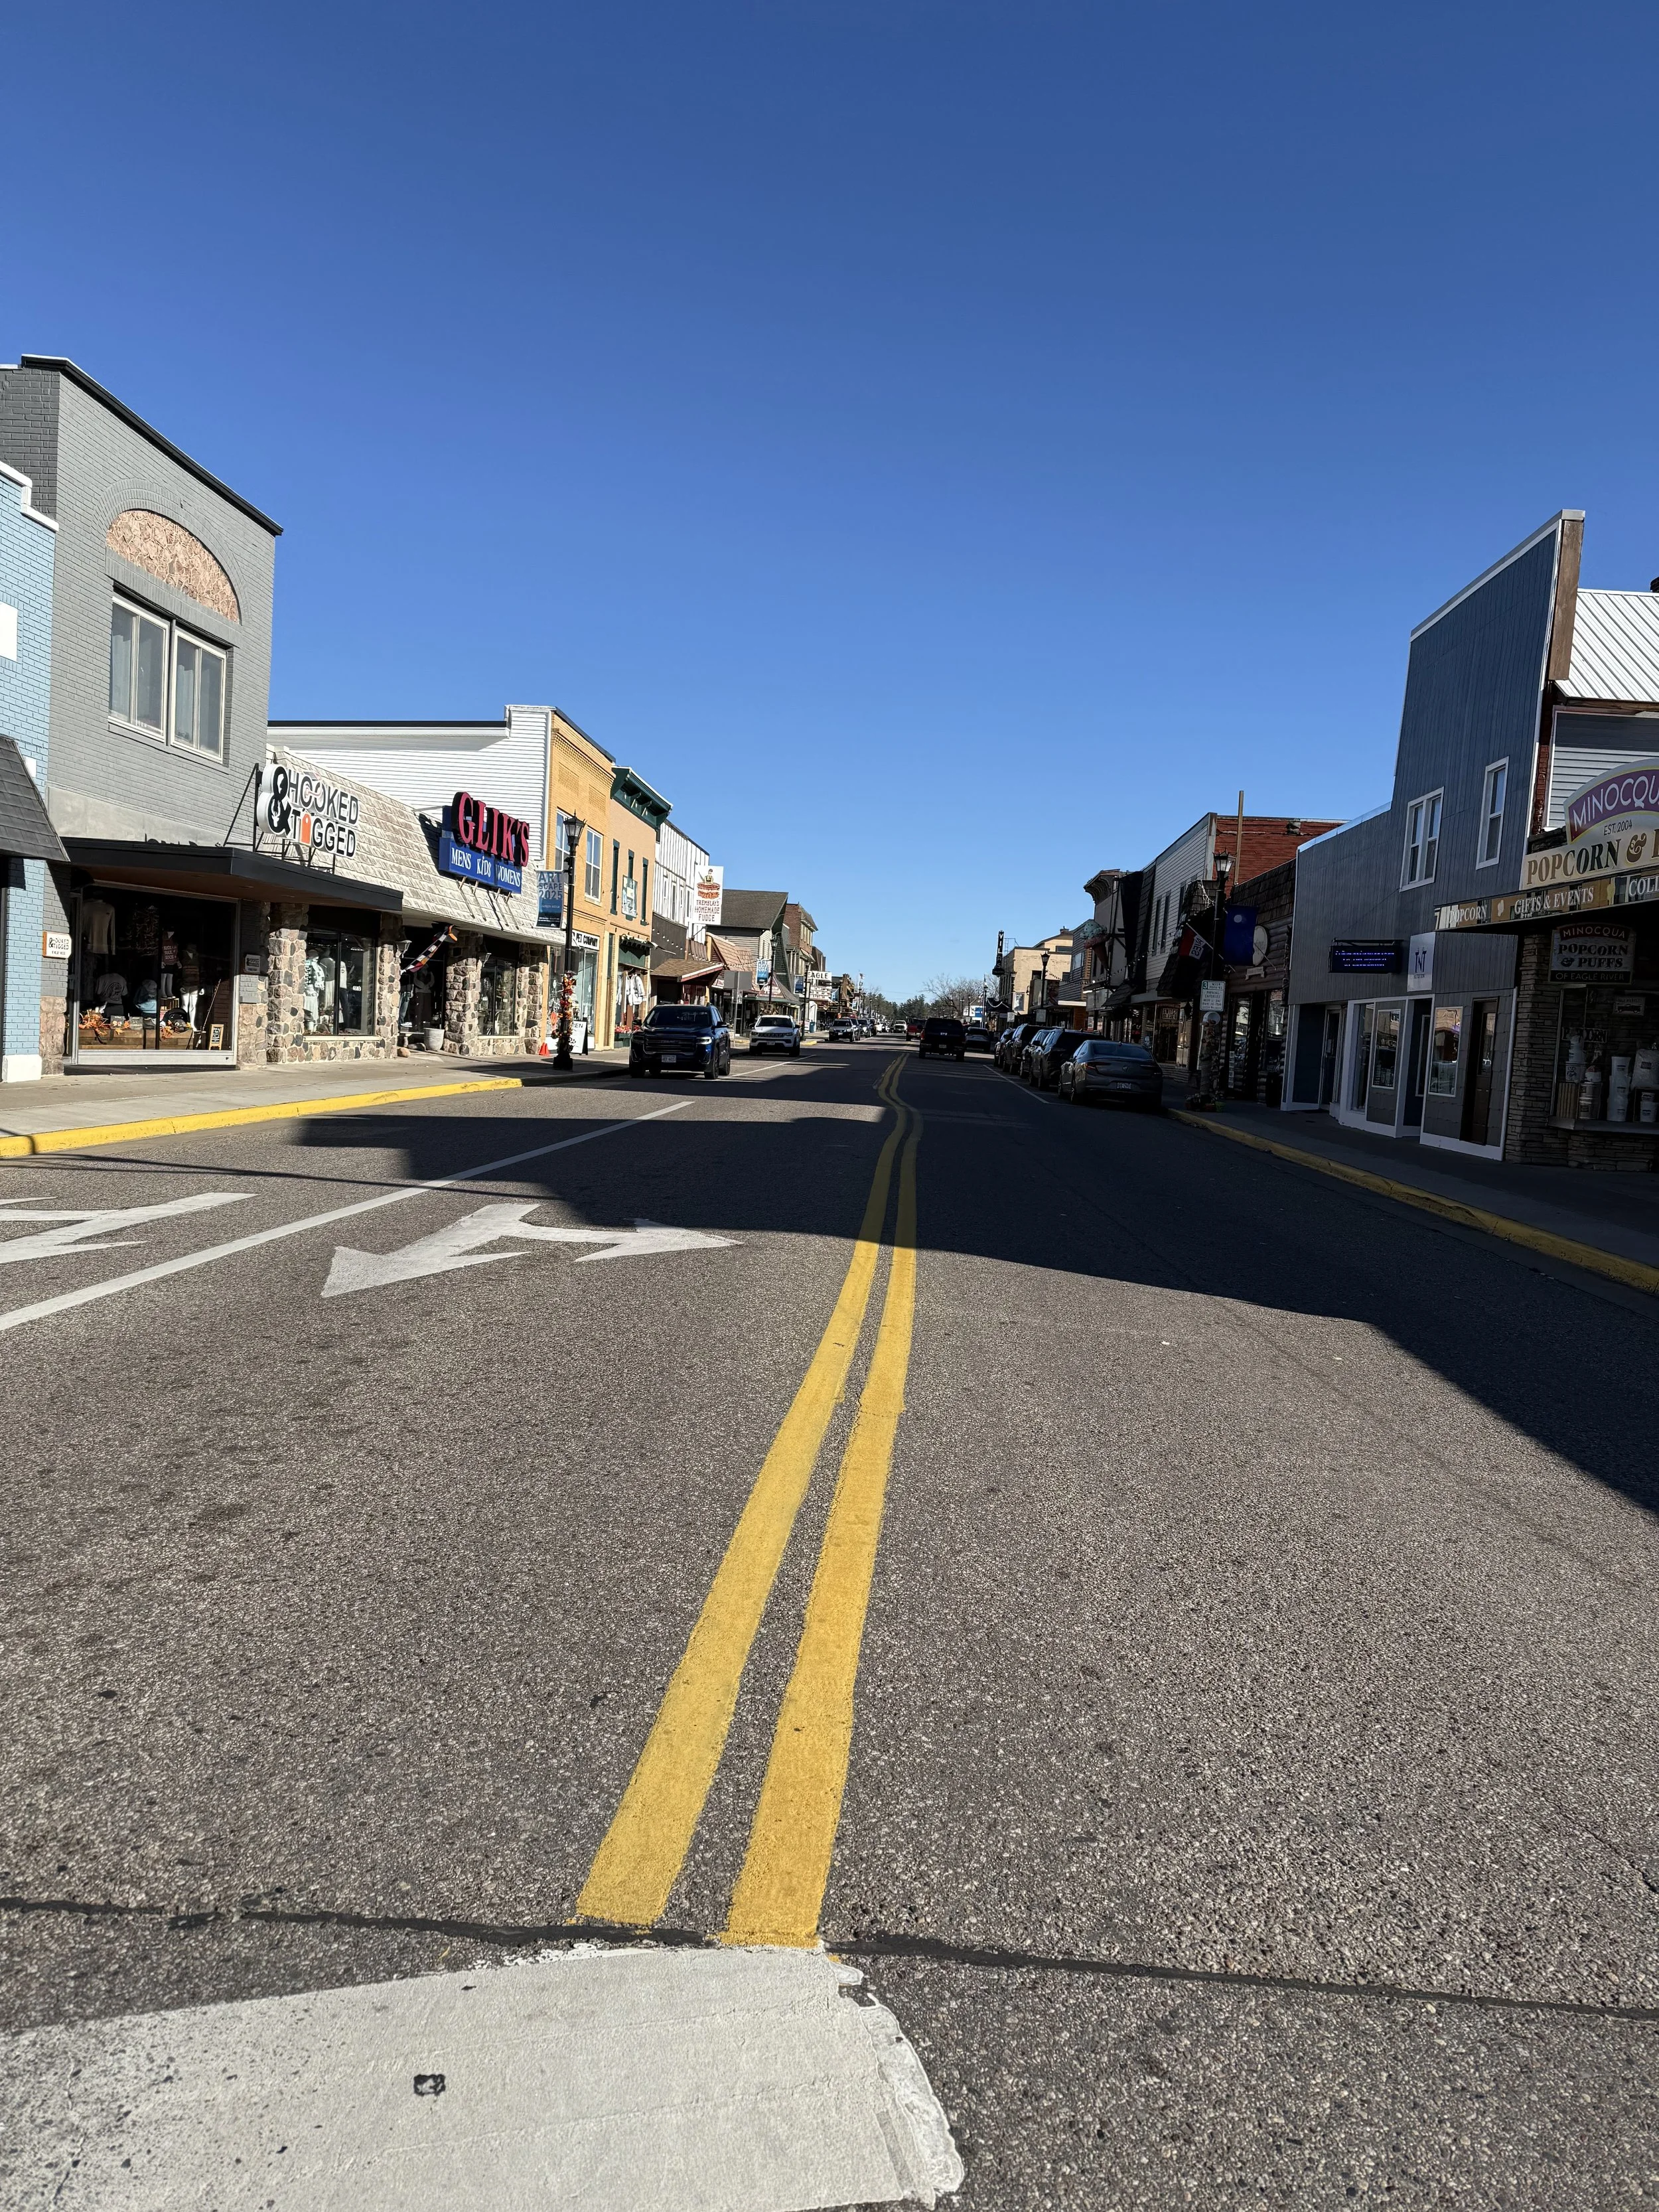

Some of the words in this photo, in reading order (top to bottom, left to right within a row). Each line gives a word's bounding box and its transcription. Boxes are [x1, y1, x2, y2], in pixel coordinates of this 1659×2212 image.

[288, 769, 359, 825] HOOKED
[1573, 774, 1659, 832] MINOCQU
[457, 791, 530, 867] GLIK'S
[1617, 819, 1632, 834] 2004
[451, 847, 471, 870] MENS
[495, 864, 521, 887] WOMENS
[1526, 838, 1621, 885] POPCORN
[1626, 832, 1647, 863] &
[538, 871, 561, 883] ART
[539, 890, 563, 899] 2025
[1449, 905, 1487, 924] POPCORN
[1514, 896, 1542, 915] GIFTS
[1542, 895, 1551, 909] &
[1553, 887, 1595, 907] EVENTS
[1563, 926, 1625, 939] MINOCQUA
[1557, 944, 1629, 956] POPCORN
[1561, 957, 1575, 967] &
[1578, 957, 1623, 968] PUFFS
